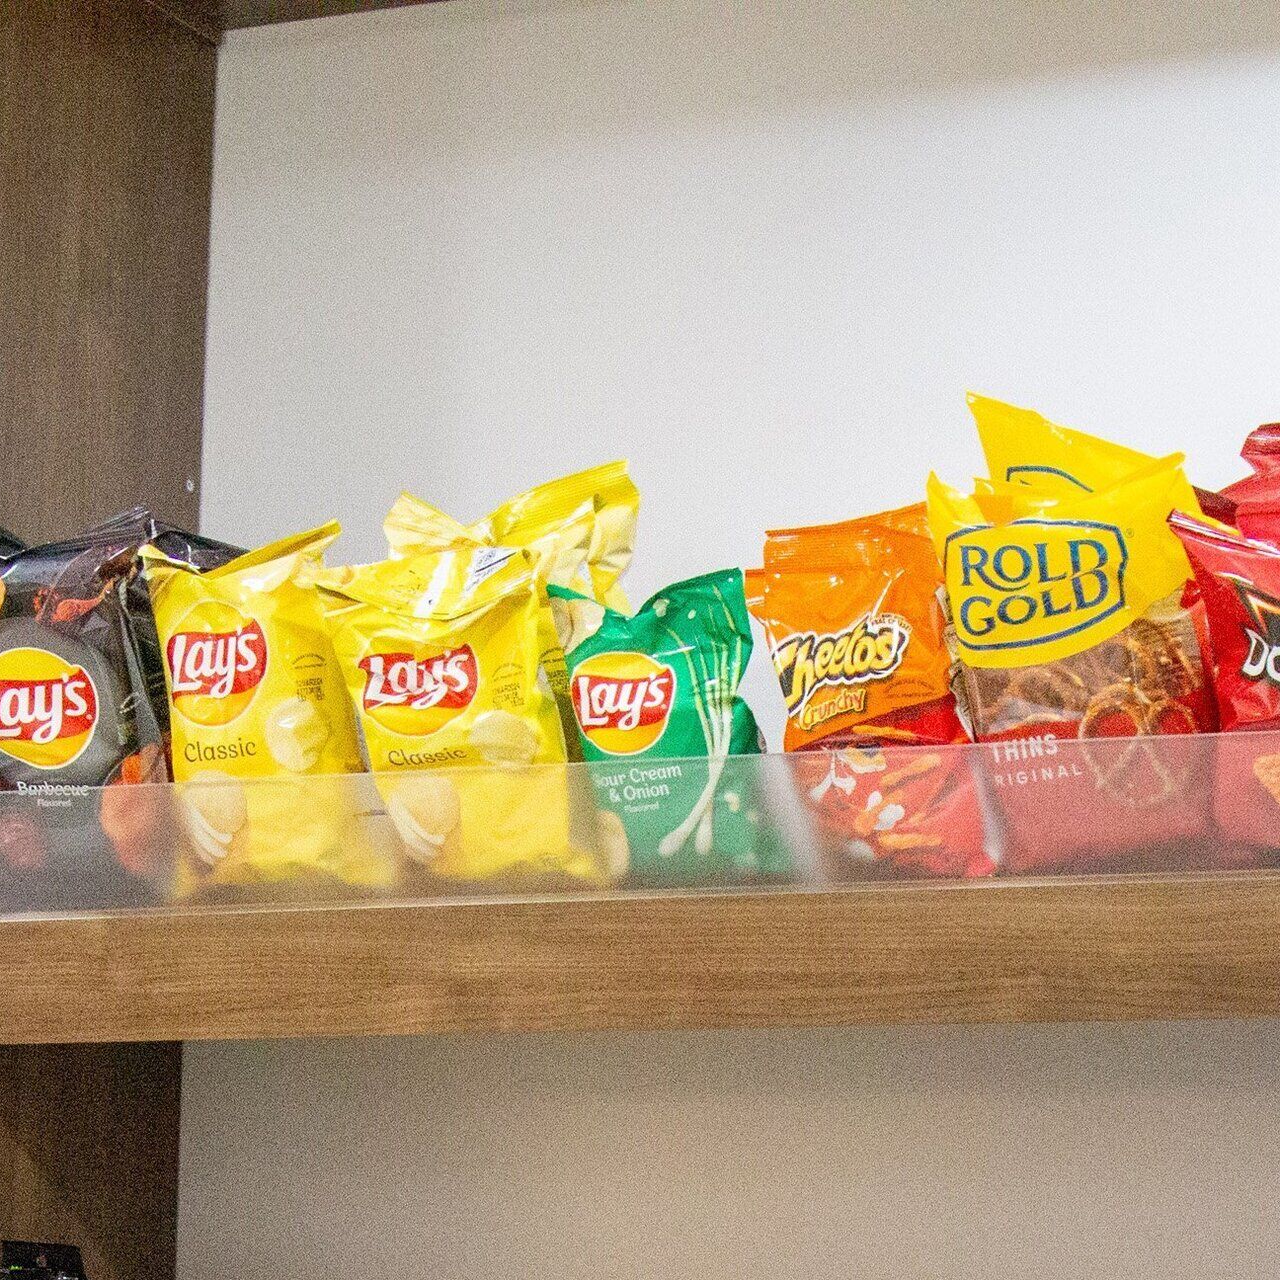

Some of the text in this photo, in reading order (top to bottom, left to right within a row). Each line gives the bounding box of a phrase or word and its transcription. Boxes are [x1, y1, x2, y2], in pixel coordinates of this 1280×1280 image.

[960, 538, 1112, 591] ROLD
[960, 570, 1110, 637] GOLD
[171, 626, 259, 700] Lay's
[364, 647, 471, 707] Lay's
[578, 673, 669, 731] Lay's
[799, 688, 867, 731] Crunchy
[184, 737, 257, 763] Classic
[388, 747, 468, 768] Classic
[991, 733, 1059, 763] THINS
[17, 780, 90, 797] Barbecue
[630, 765, 682, 783] Cream
[609, 783, 670, 802] & Onion
